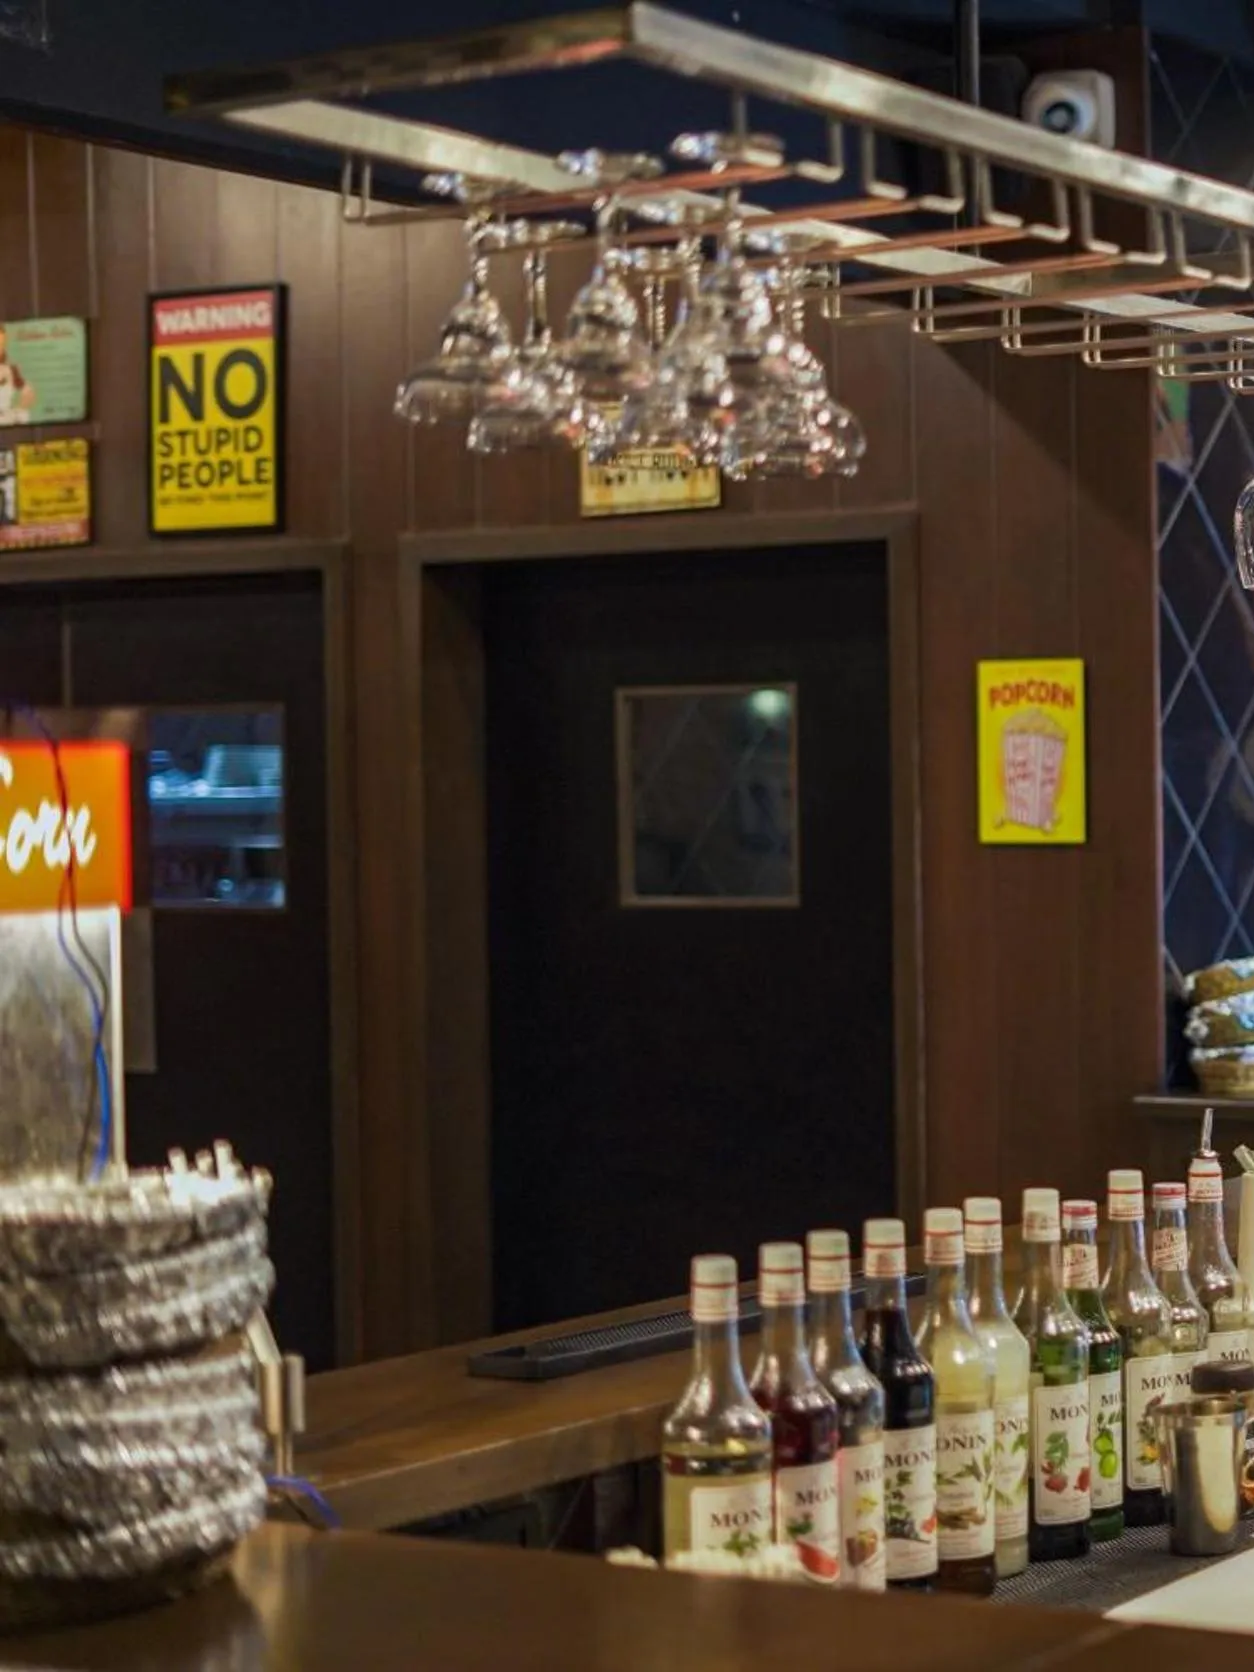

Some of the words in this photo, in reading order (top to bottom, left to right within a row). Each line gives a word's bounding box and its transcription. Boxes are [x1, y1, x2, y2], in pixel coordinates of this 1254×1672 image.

[157, 303, 271, 333] WARNING
[158, 348, 267, 424] NO
[158, 425, 264, 458] STUPID
[158, 457, 272, 490] PEOPLE
[988, 679, 1076, 710] POPCORN
[0, 752, 97, 876] orn
